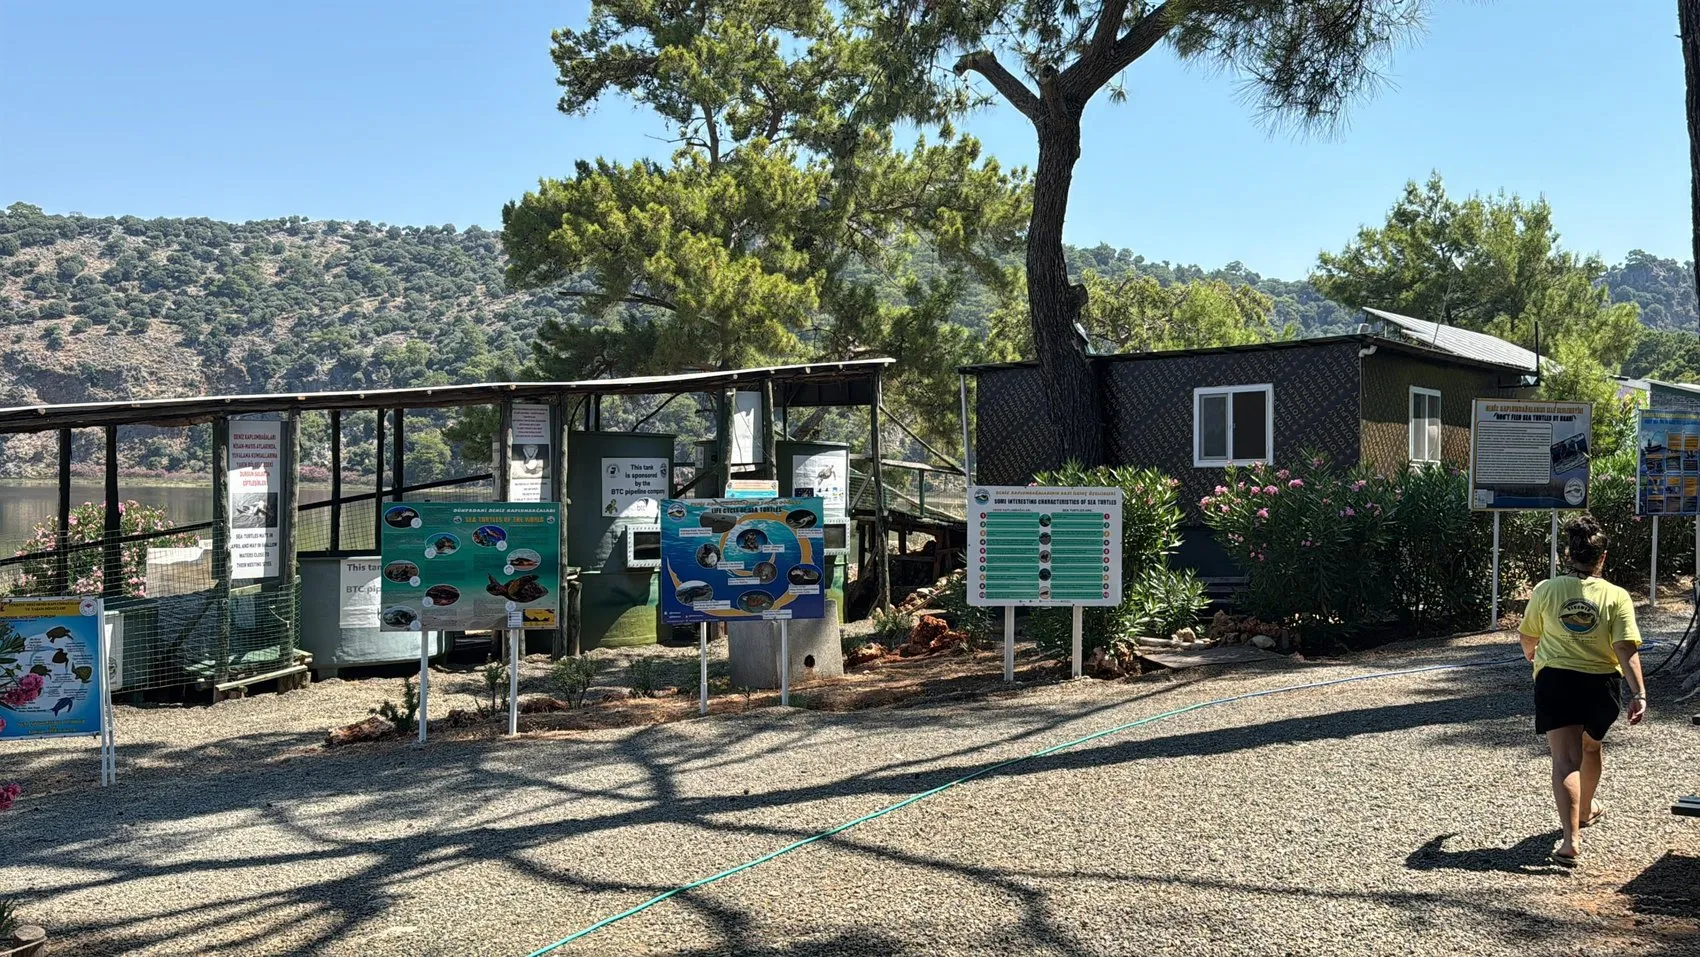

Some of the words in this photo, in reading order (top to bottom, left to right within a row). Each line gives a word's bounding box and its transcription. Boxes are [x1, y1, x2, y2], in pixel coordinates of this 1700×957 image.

[1298, 368, 1324, 401] TOTALPLY
[1305, 362, 1332, 395] TOTALPLY
[1313, 356, 1340, 389] TOTALPLY
[1275, 387, 1301, 419] TOTALPLY
[1283, 380, 1309, 413] TOTALPLY
[1290, 374, 1316, 407] TOTALPLY
[1320, 415, 1347, 449] TOTALPLY
[1328, 408, 1355, 443] TOTALPLY
